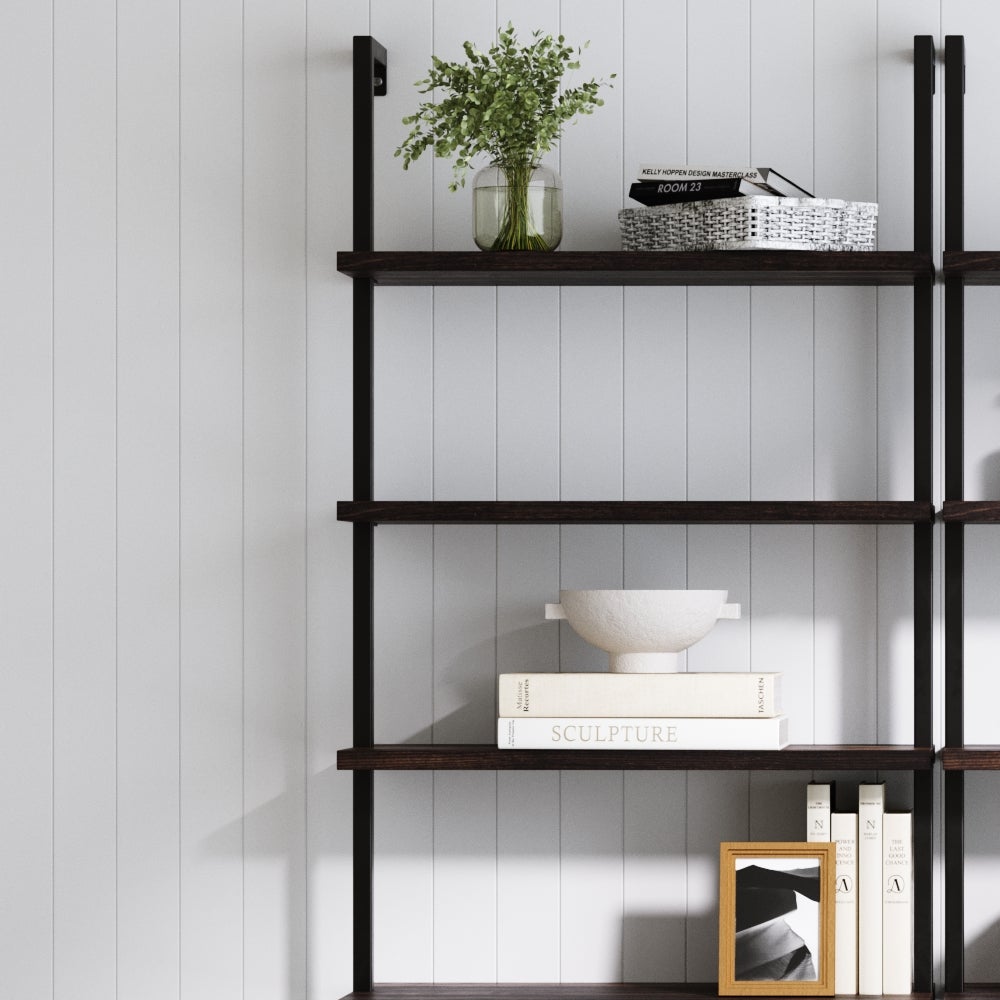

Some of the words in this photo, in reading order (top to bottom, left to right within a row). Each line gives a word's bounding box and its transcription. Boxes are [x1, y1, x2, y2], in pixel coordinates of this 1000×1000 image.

[642, 168, 662, 176] KELLY
[662, 169, 687, 177] HOPPEN
[712, 170, 758, 179] MASTERCLASS
[657, 183, 689, 193] ROOM
[690, 182, 702, 192] 23
[551, 725, 678, 743] SCULPTURE
